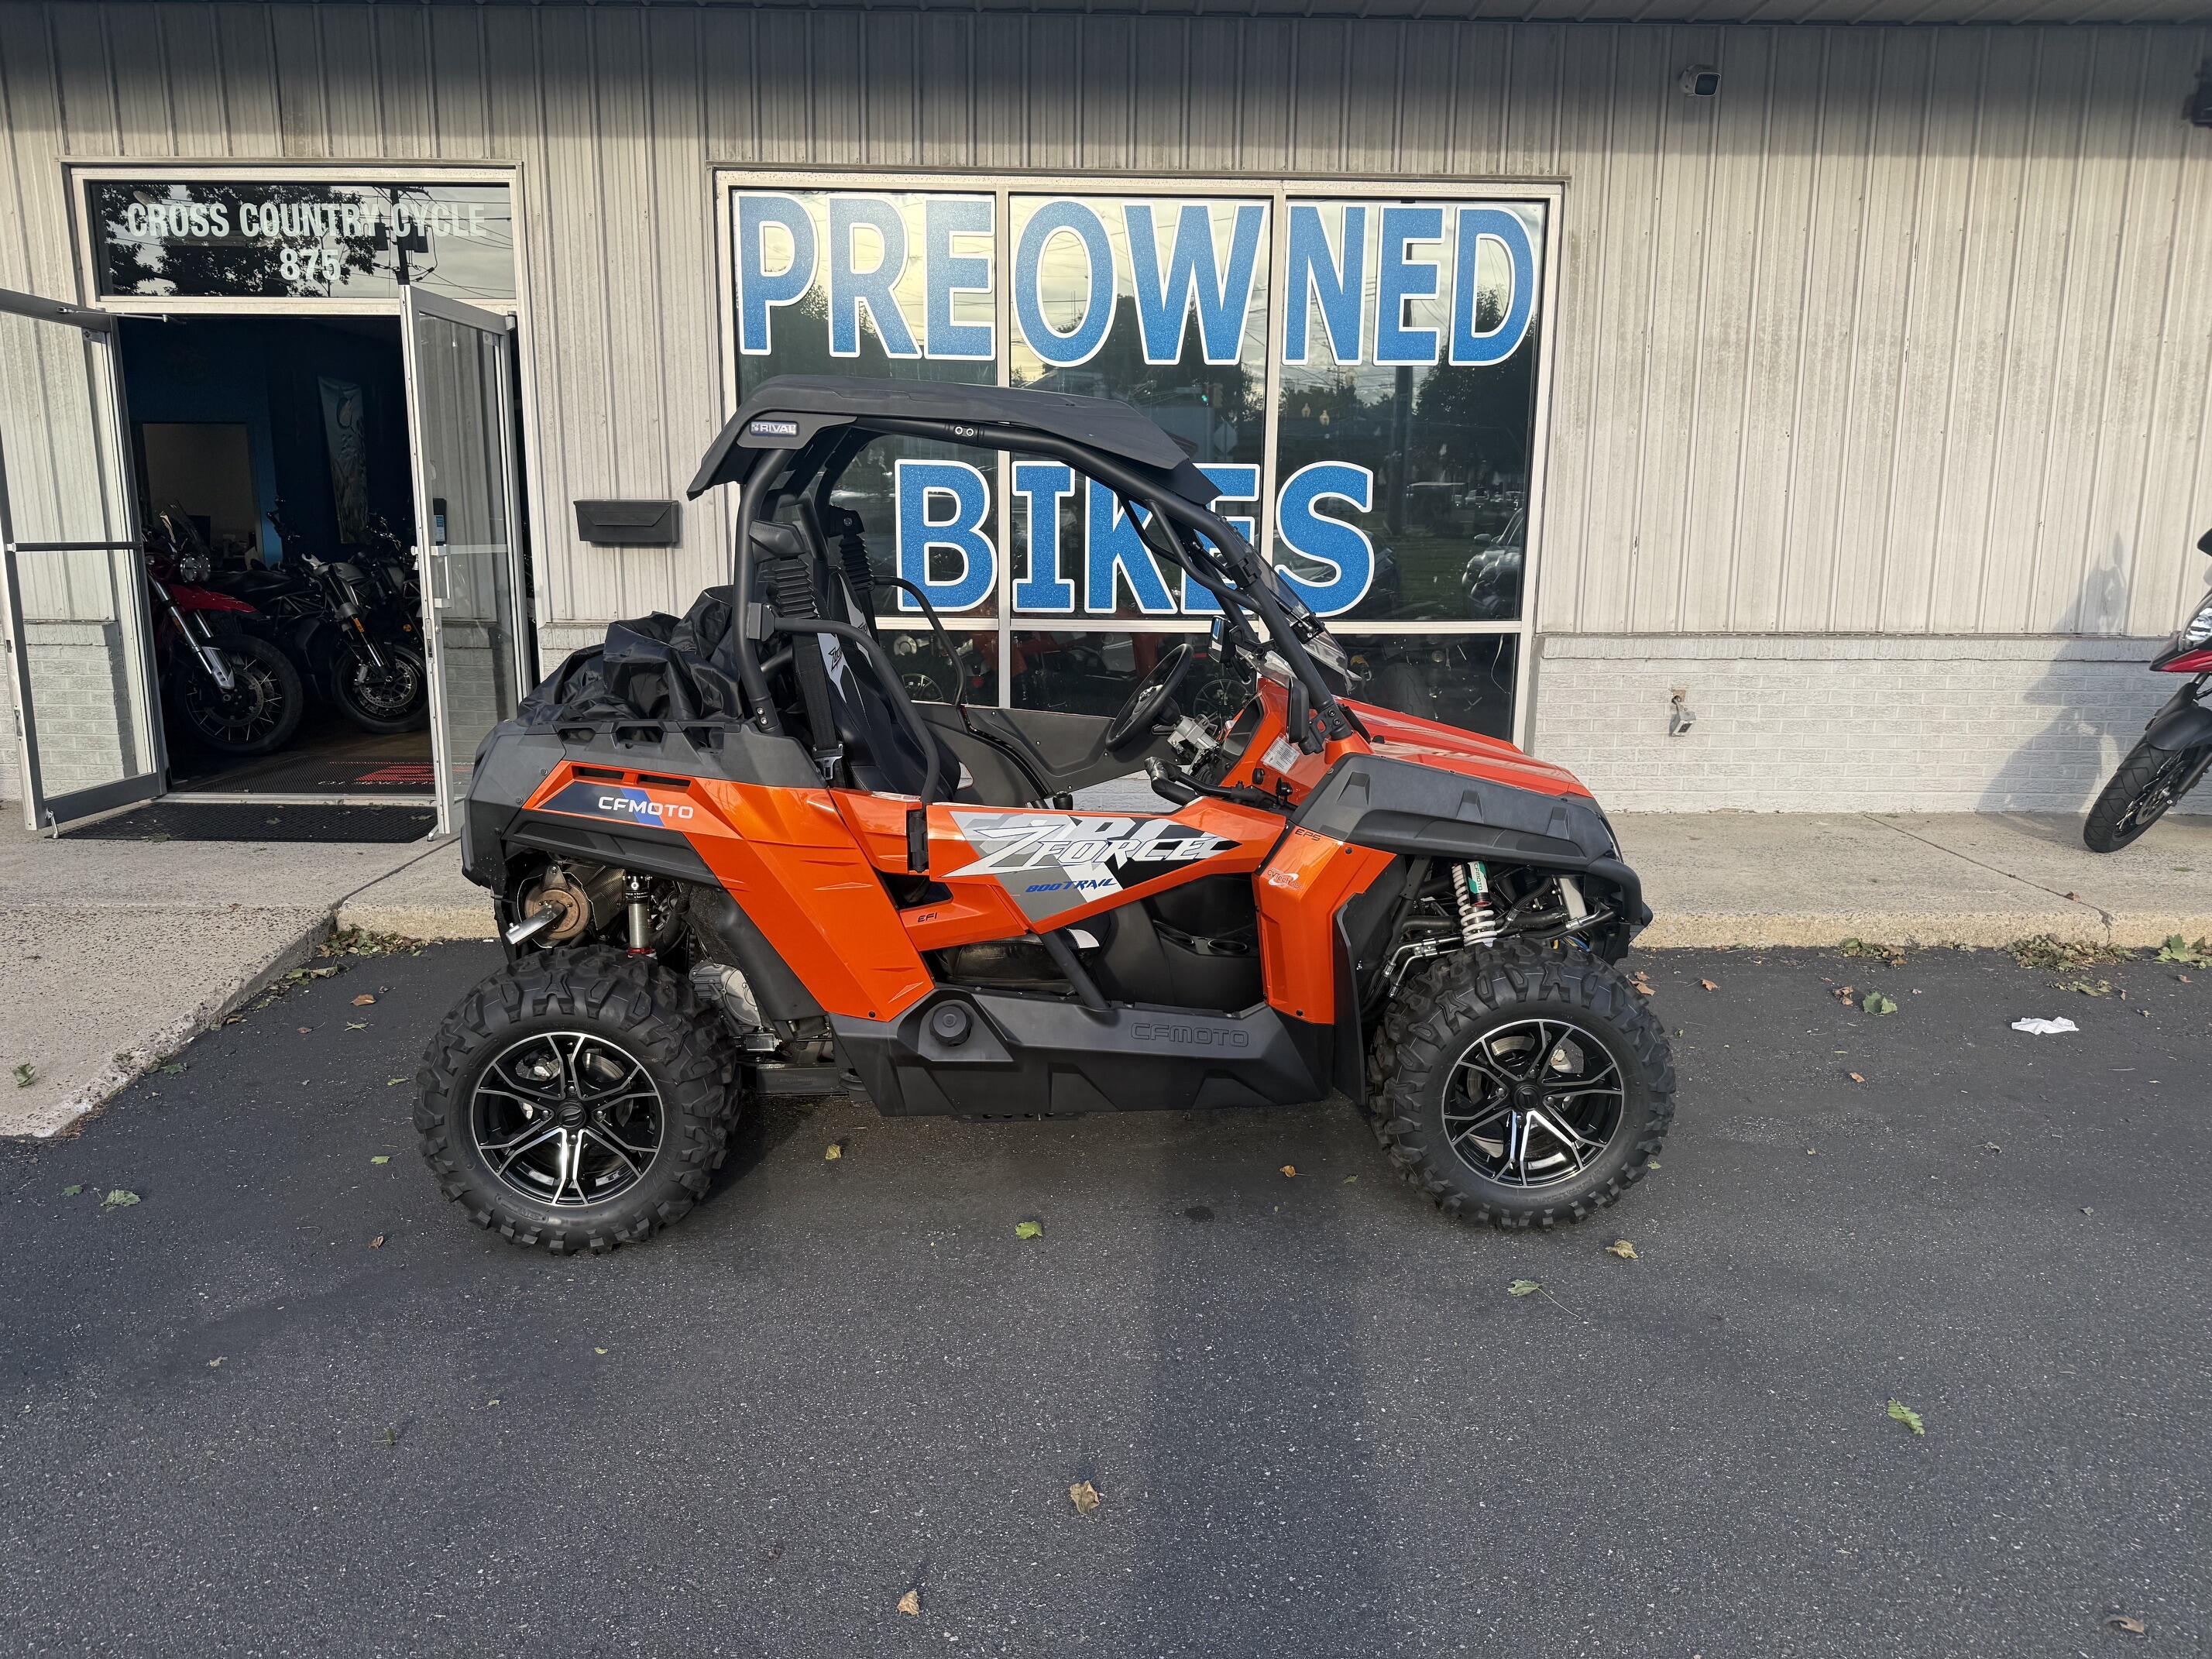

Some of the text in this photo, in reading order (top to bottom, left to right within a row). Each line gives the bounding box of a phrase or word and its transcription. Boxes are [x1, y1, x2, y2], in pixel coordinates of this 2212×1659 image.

[127, 202, 487, 238] CROSS COUNTRY CYCLE
[280, 248, 341, 280] 875
[734, 191, 1536, 368] PREOWNED
[760, 424, 796, 434] RIVAL
[894, 459, 1374, 617] BIKES
[598, 796, 694, 819] CFMOTO
[1295, 828, 1321, 841] EPS
[918, 912, 937, 922] EFI
[1131, 1022, 1249, 1047] CFMOTO
